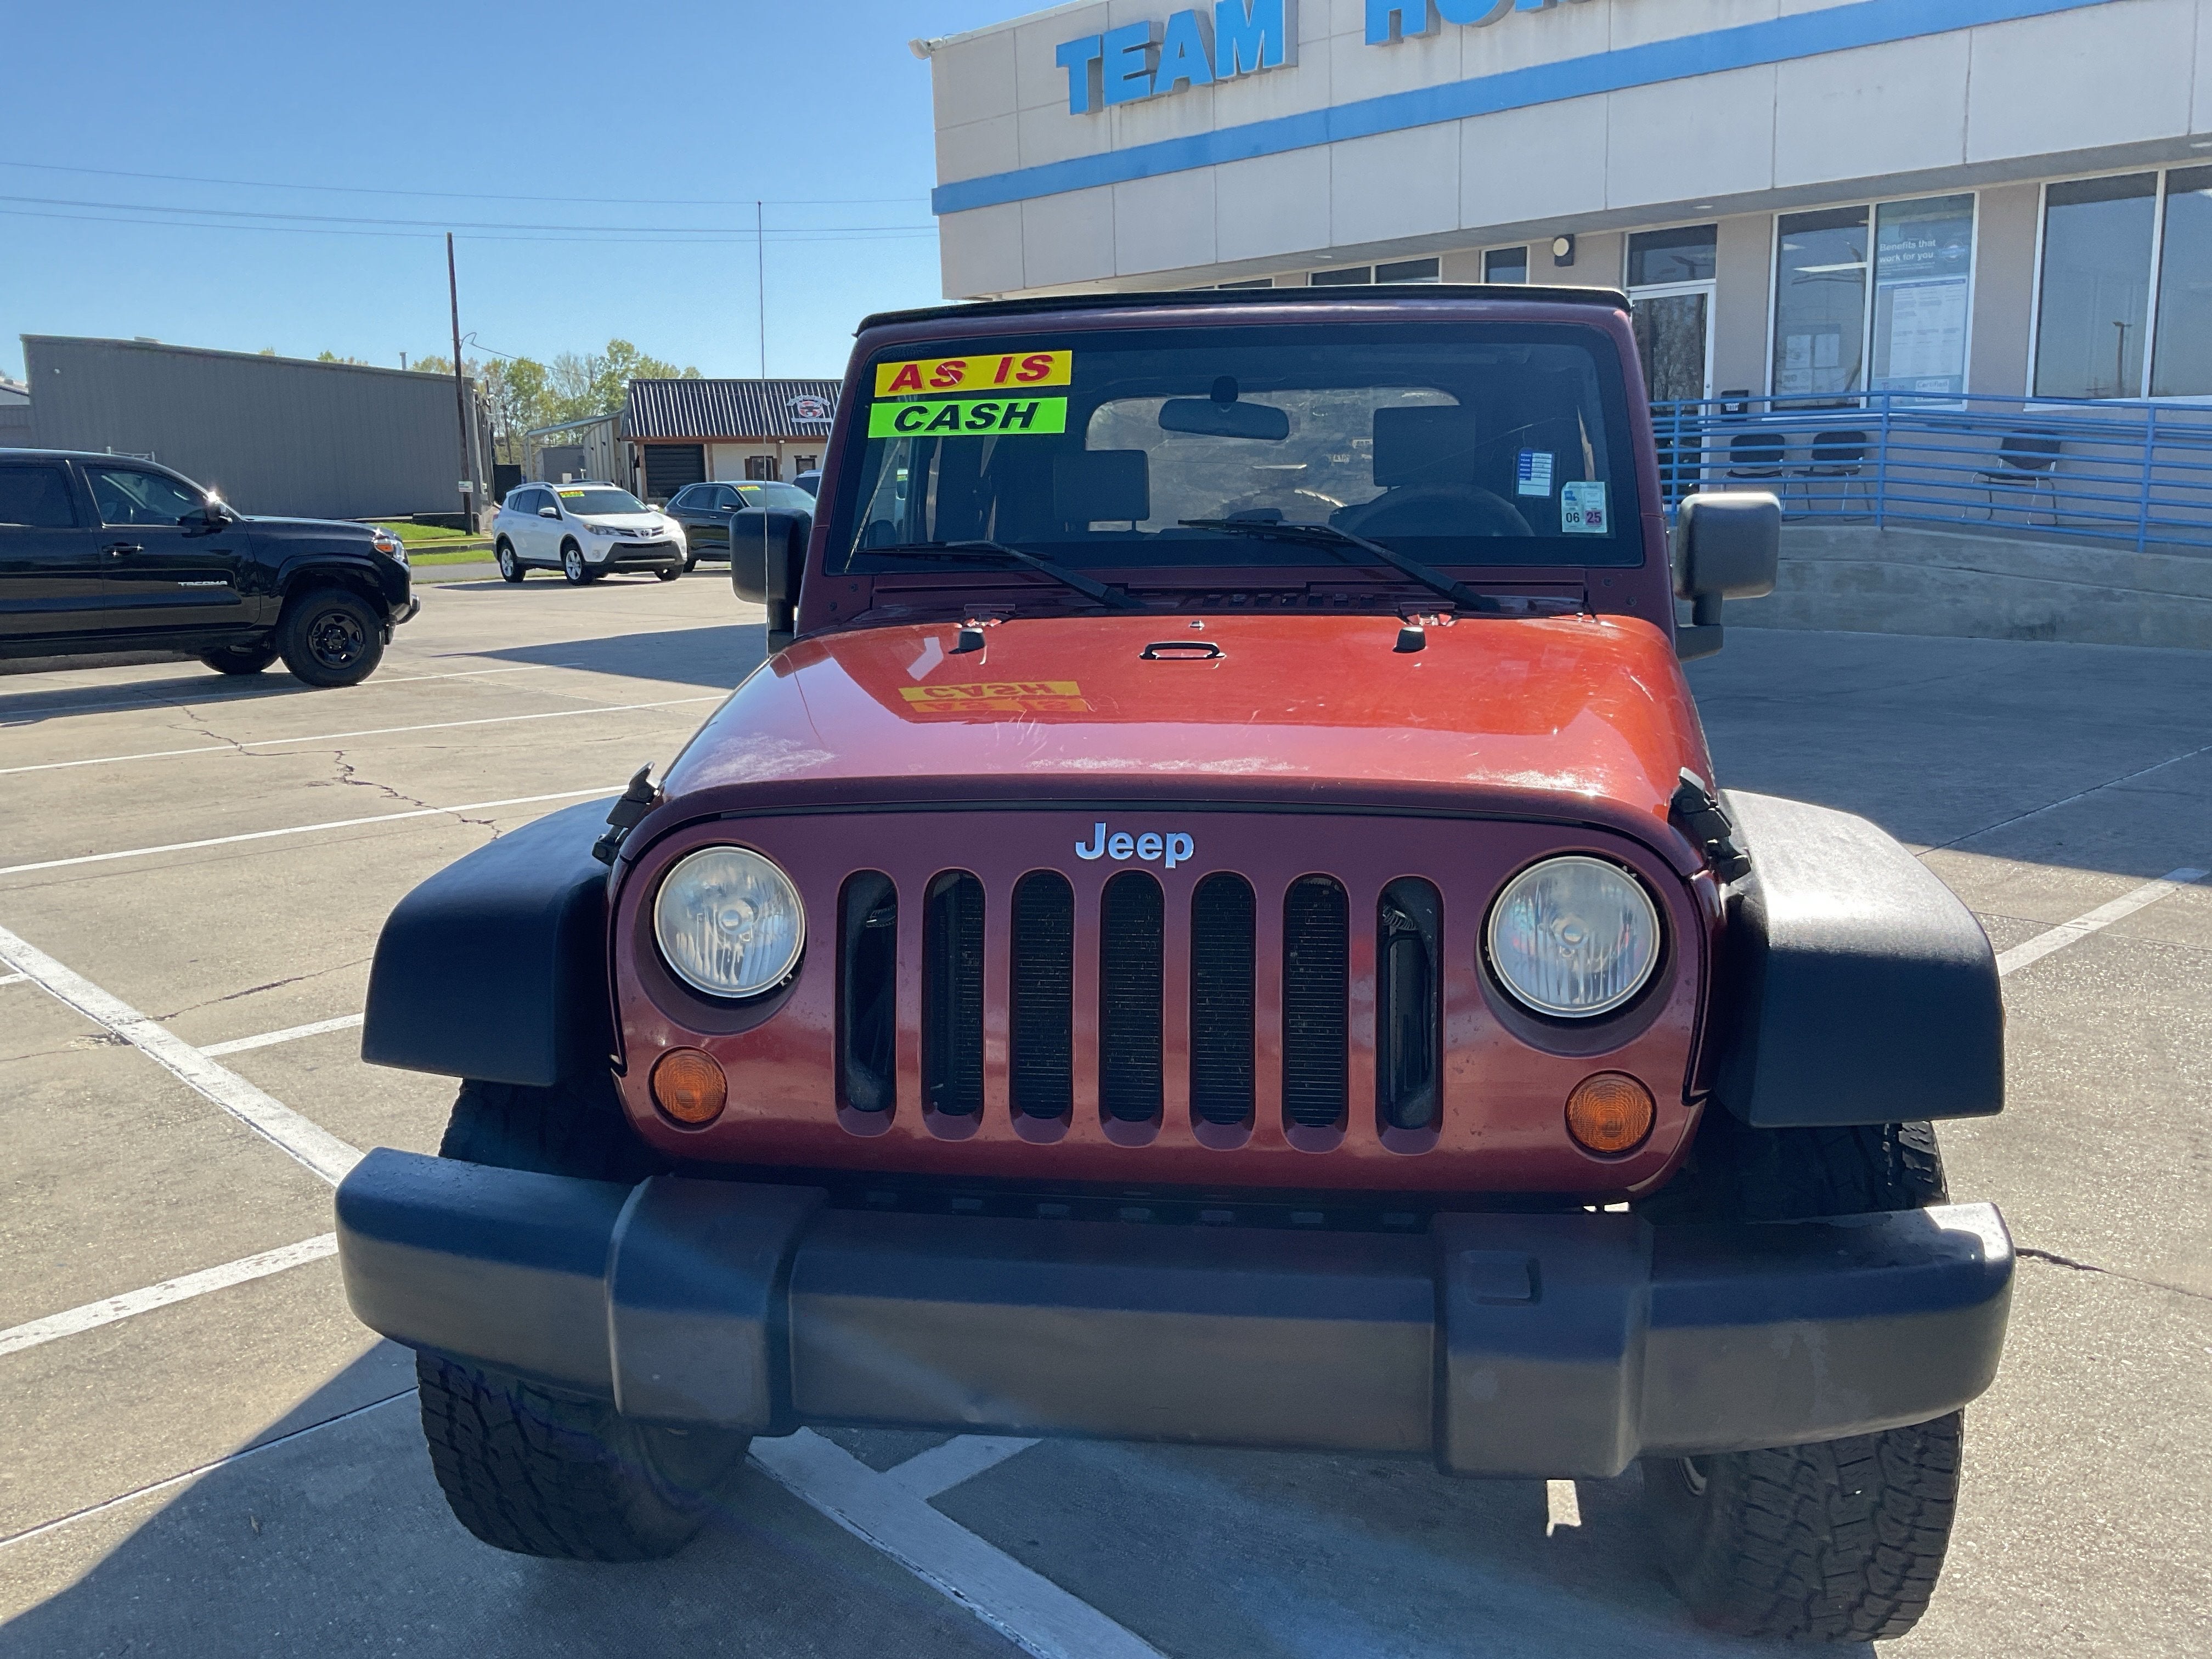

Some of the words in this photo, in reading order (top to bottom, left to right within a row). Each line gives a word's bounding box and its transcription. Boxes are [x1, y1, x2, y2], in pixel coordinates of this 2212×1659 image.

[1056, 0, 1289, 115] TEAM
[1878, 254, 1900, 263] work
[1903, 252, 1916, 261] for
[1879, 241, 1916, 251] Benefits
[1918, 239, 1936, 248] that
[888, 360, 967, 392] AS
[994, 354, 1054, 384] IS
[894, 402, 1040, 433] CASH
[1566, 512, 1580, 523] 06
[1587, 511, 1602, 523] 25
[1075, 822, 1195, 869] Jeep
